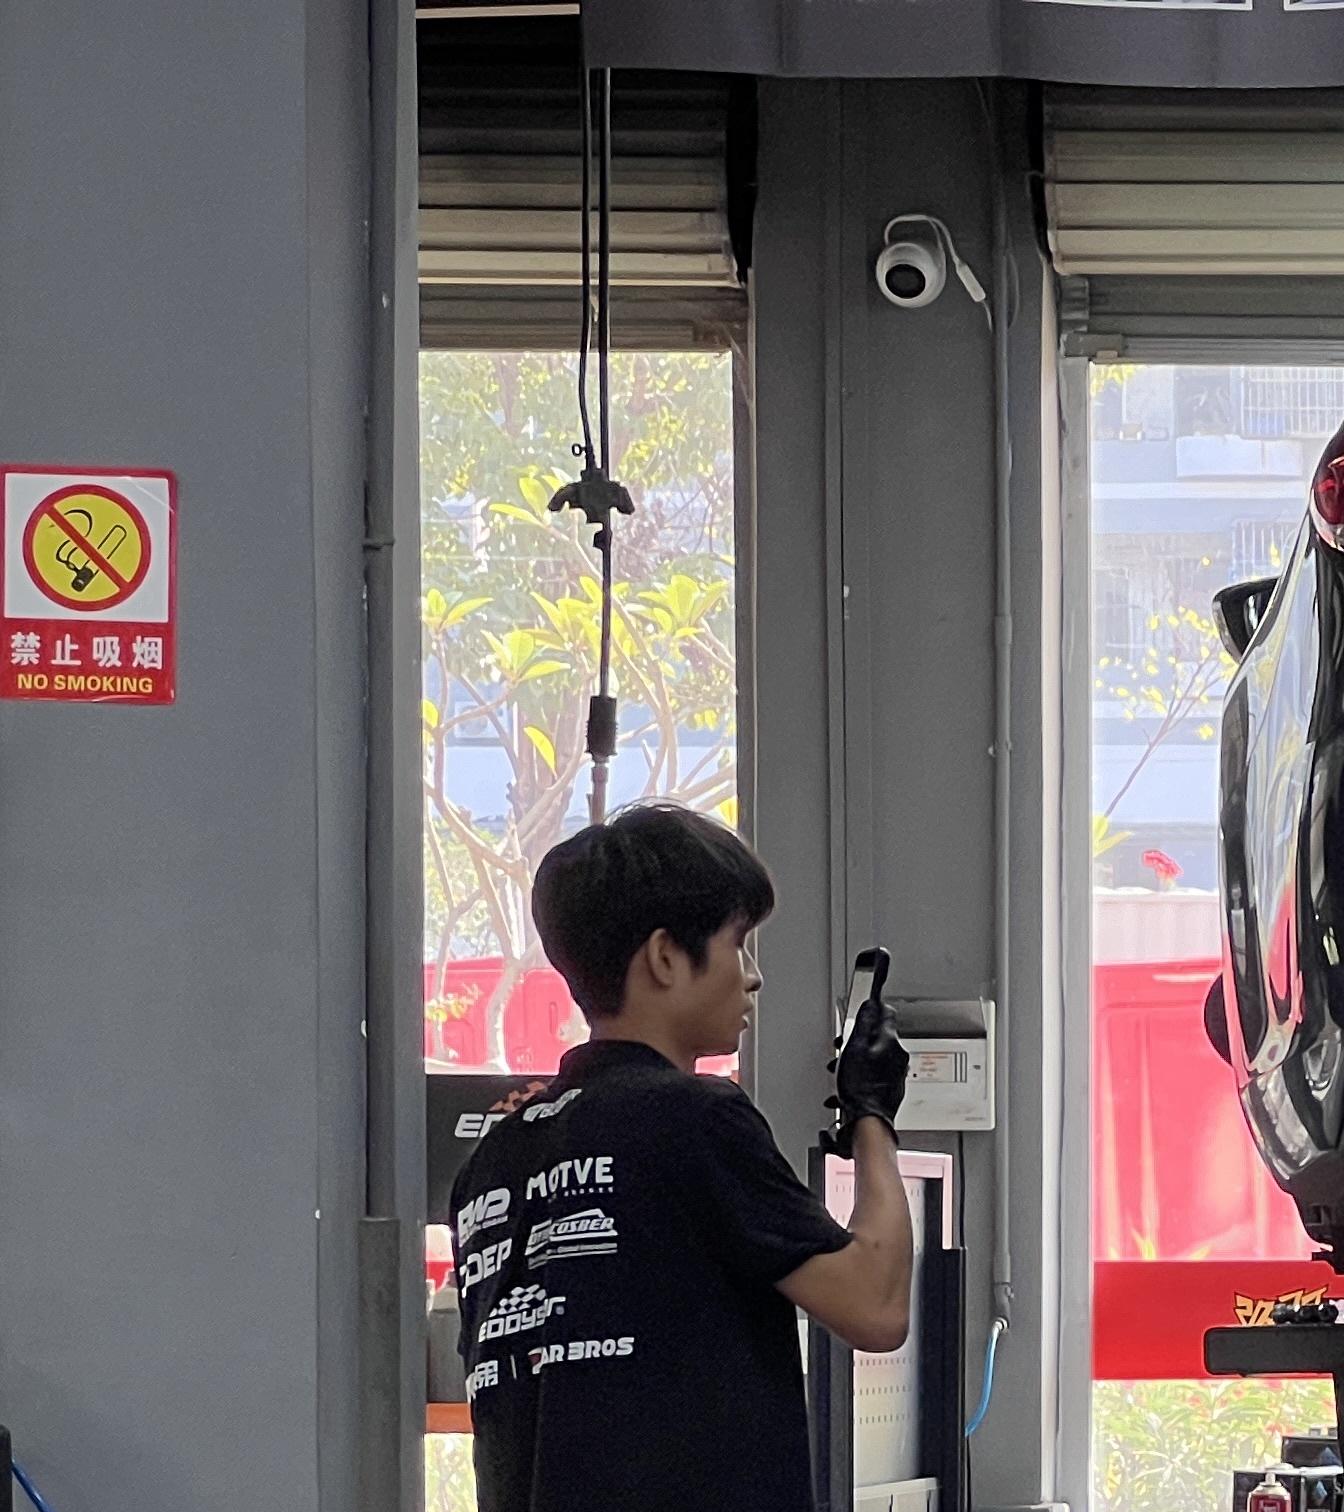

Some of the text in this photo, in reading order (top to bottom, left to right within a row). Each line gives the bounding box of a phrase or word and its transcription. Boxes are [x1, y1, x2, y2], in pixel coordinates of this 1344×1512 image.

[10, 631, 164, 670] 禁止吸烟
[17, 673, 154, 694] NO SMOKING
[567, 1336, 635, 1361] BROS
